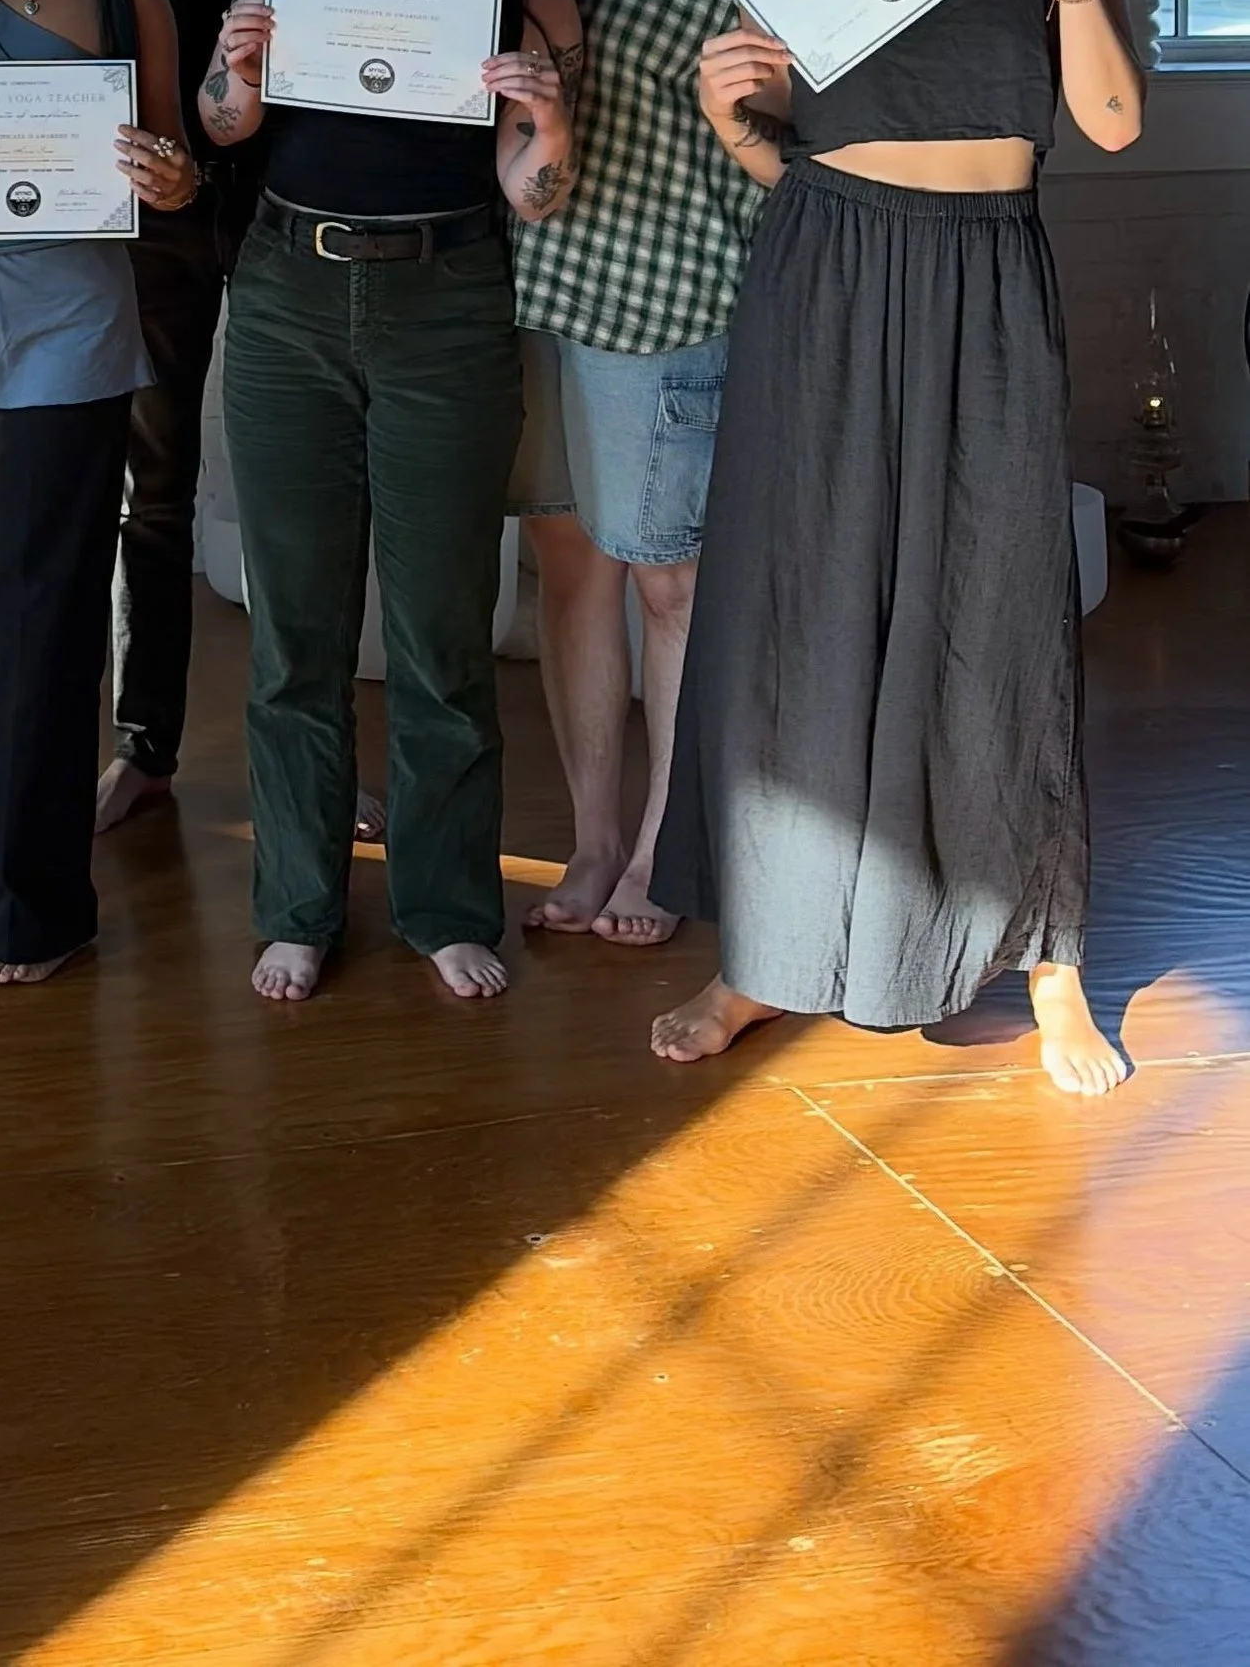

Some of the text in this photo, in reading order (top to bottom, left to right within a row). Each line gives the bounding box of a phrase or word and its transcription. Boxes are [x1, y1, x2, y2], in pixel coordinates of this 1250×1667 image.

[7, 93, 42, 103] YOGA
[48, 92, 106, 103] TEACHER
[29, 108, 79, 122] completion
